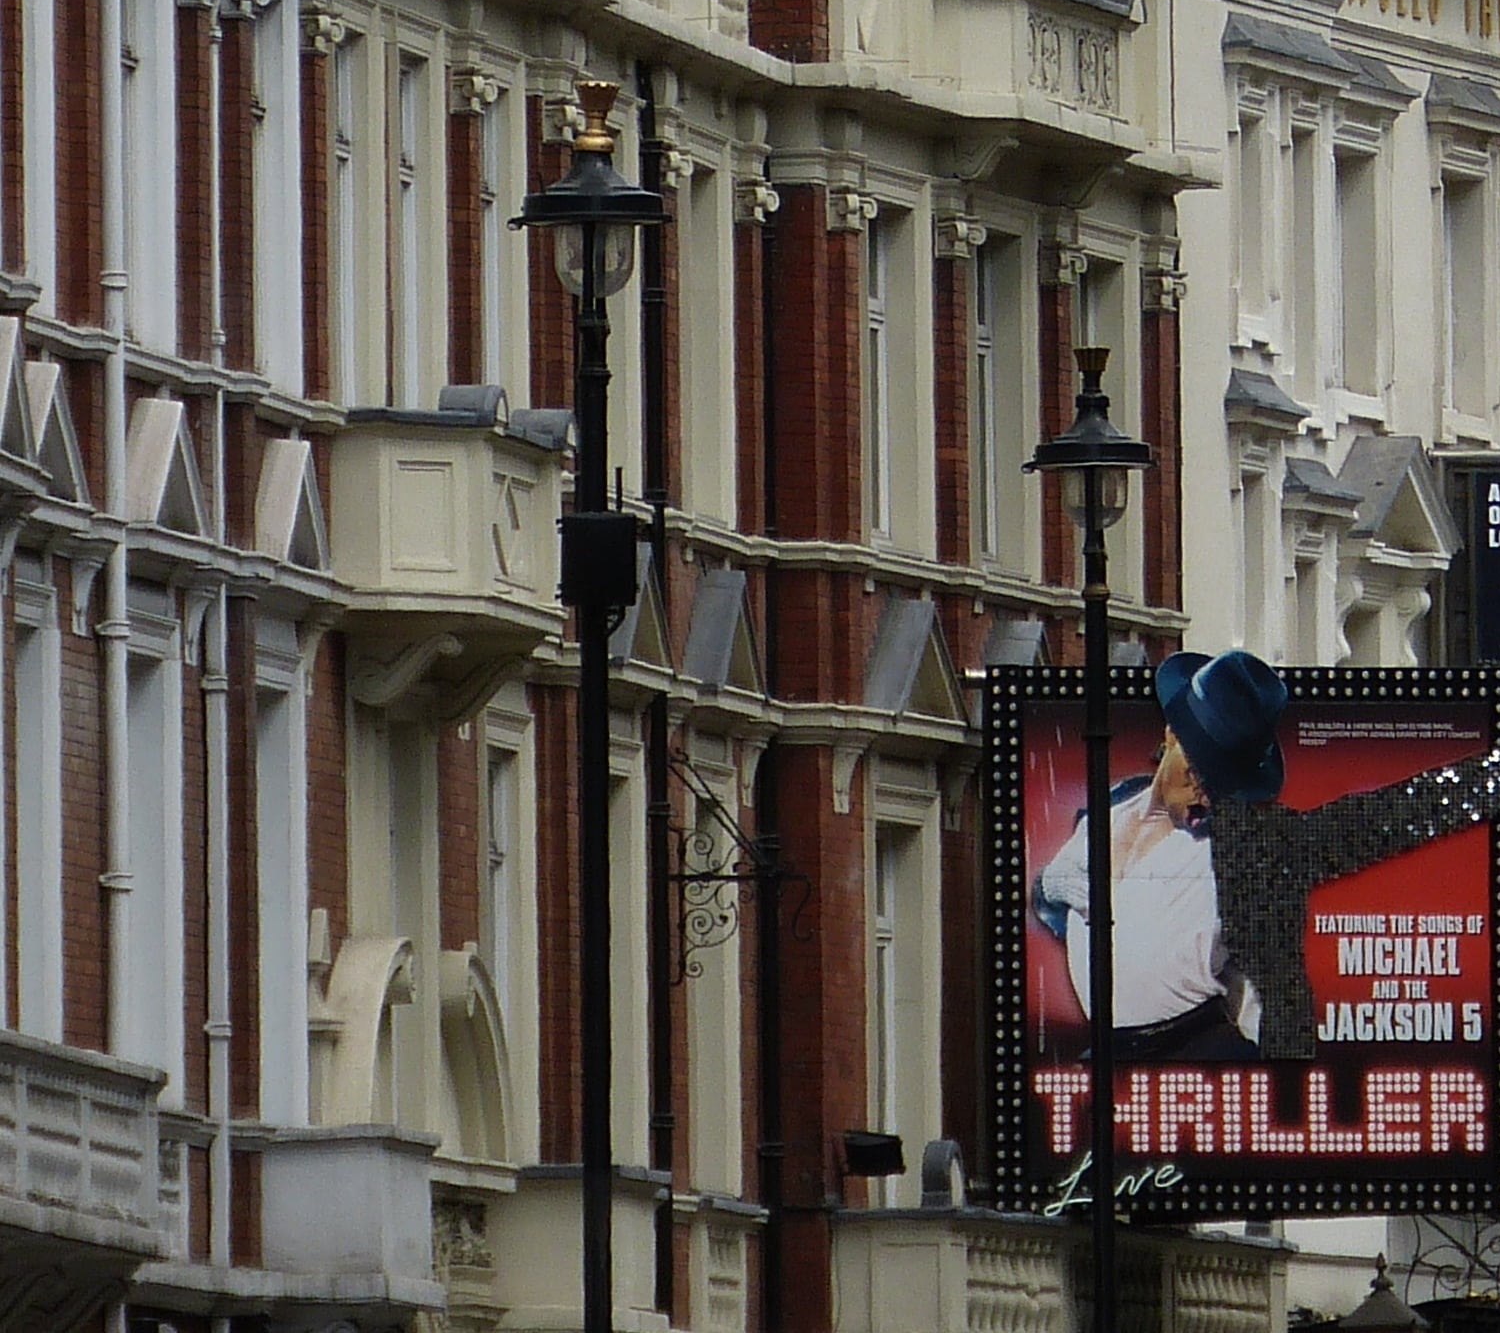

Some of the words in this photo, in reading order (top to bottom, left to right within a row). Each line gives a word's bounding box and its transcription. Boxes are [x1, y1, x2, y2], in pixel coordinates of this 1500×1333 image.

[1488, 483, 1500, 502] A
[1315, 915, 1386, 933] FEATURING
[1389, 915, 1413, 933] THE
[1418, 915, 1462, 933] SONGS
[1466, 915, 1483, 933] OF
[1338, 937, 1460, 975] MICHAEL
[1372, 981, 1399, 999] AND
[1403, 981, 1428, 999] THE
[1317, 1002, 1453, 1042] JACKSON
[1462, 1002, 1482, 1042] 5
[1035, 1073, 1485, 1153] THRILLER
[1044, 1152, 1184, 1216] Lve
